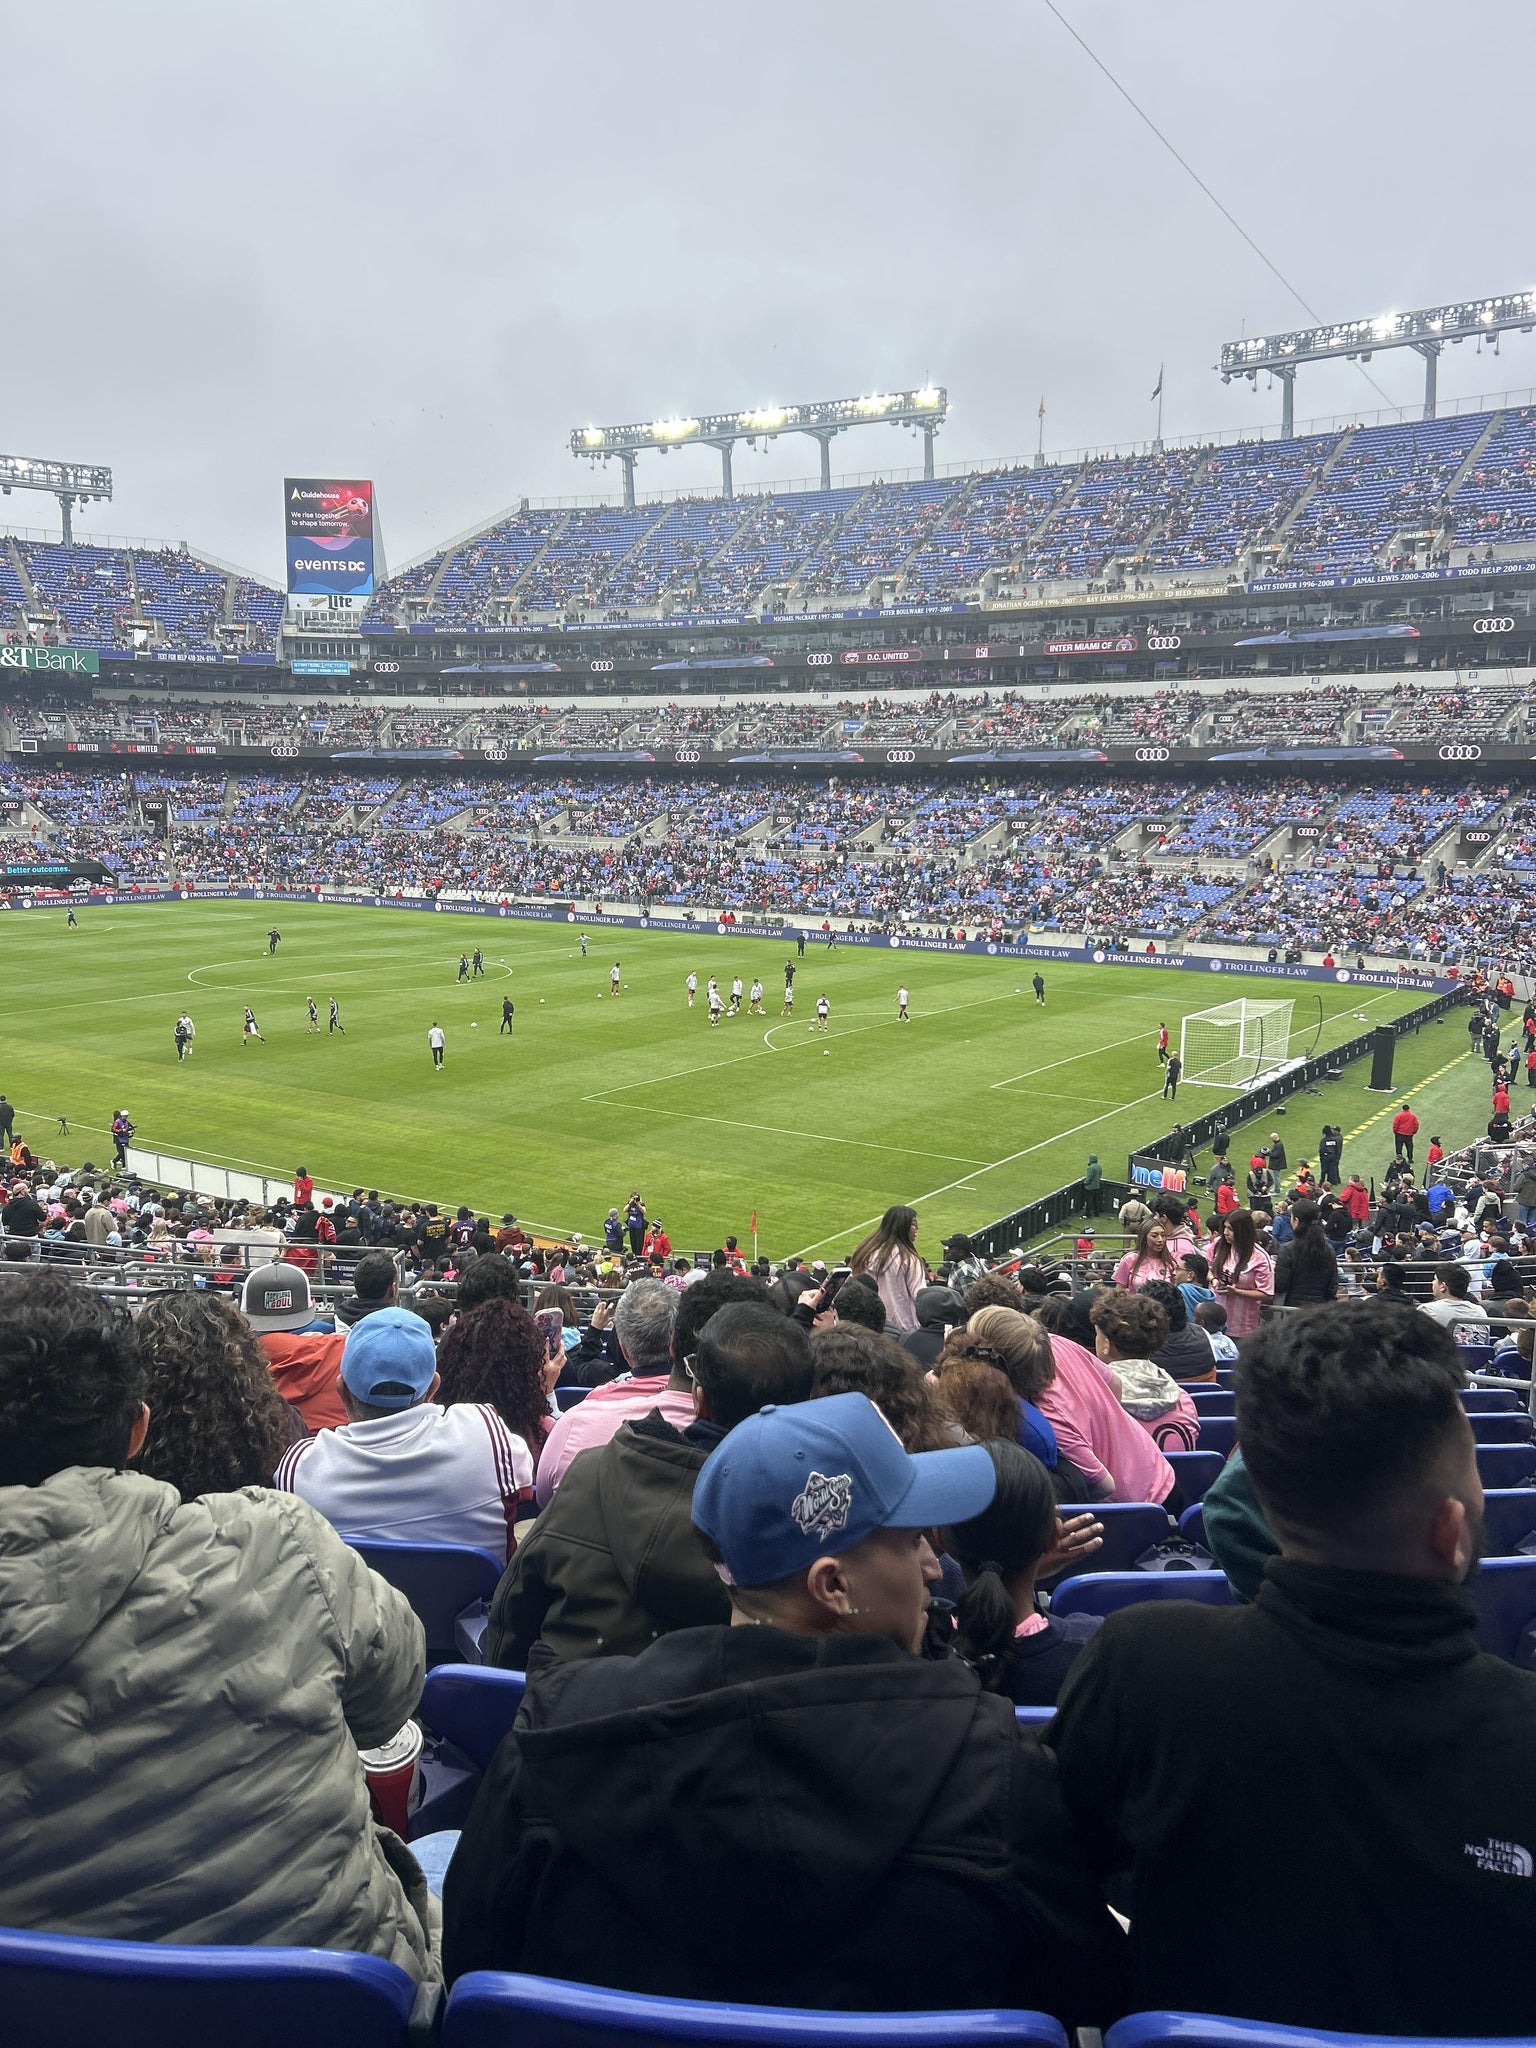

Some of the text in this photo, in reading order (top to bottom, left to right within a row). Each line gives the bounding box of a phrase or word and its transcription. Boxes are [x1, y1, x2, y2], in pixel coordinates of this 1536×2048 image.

[300, 491, 340, 499] Guidehouse
[300, 520, 318, 528] shape
[1458, 568, 1479, 576] TODD
[1481, 566, 1501, 575] HEAP
[1353, 572, 1440, 585] JAMAL LEWIS 2000-2006
[1253, 580, 1335, 591] MATT STOVER 1996-2008
[327, 594, 352, 610] Lite
[992, 601, 1022, 610] JONATHAN
[1050, 642, 1113, 652] INTER MIAMI CF
[0, 647, 87, 671] &T Bank
[867, 652, 909, 661] D.C. UNITED
[77, 743, 99, 752] UNITED
[137, 745, 158, 753] UNITED
[196, 746, 217, 754] UNITED
[7, 866, 30, 874] Better
[32, 865, 71, 873] outcomes.
[33, 897, 89, 907] TROLLINGER LAW
[474, 906, 486, 914] LAW
[575, 915, 625, 924] TROLLINGER LAW
[648, 920, 700, 930] TROLLINGER LAW
[727, 926, 783, 937] TROLLINGER LAW
[854, 936, 871, 944] LAW
[901, 939, 966, 951] TROLLINGER LAW
[999, 946, 1070, 958] TROLLINGER LAW
[1107, 953, 1185, 967] TROLLINGER LAW
[1224, 962, 1309, 977] TROLLINGER LAW
[1352, 973, 1435, 988] TROLLINGER LAW
[1131, 1163, 1186, 1192] nelif
[1487, 1837, 1514, 1853] THE
[1463, 1843, 1513, 1863] NORTH
[1476, 1857, 1510, 1874] FACE
